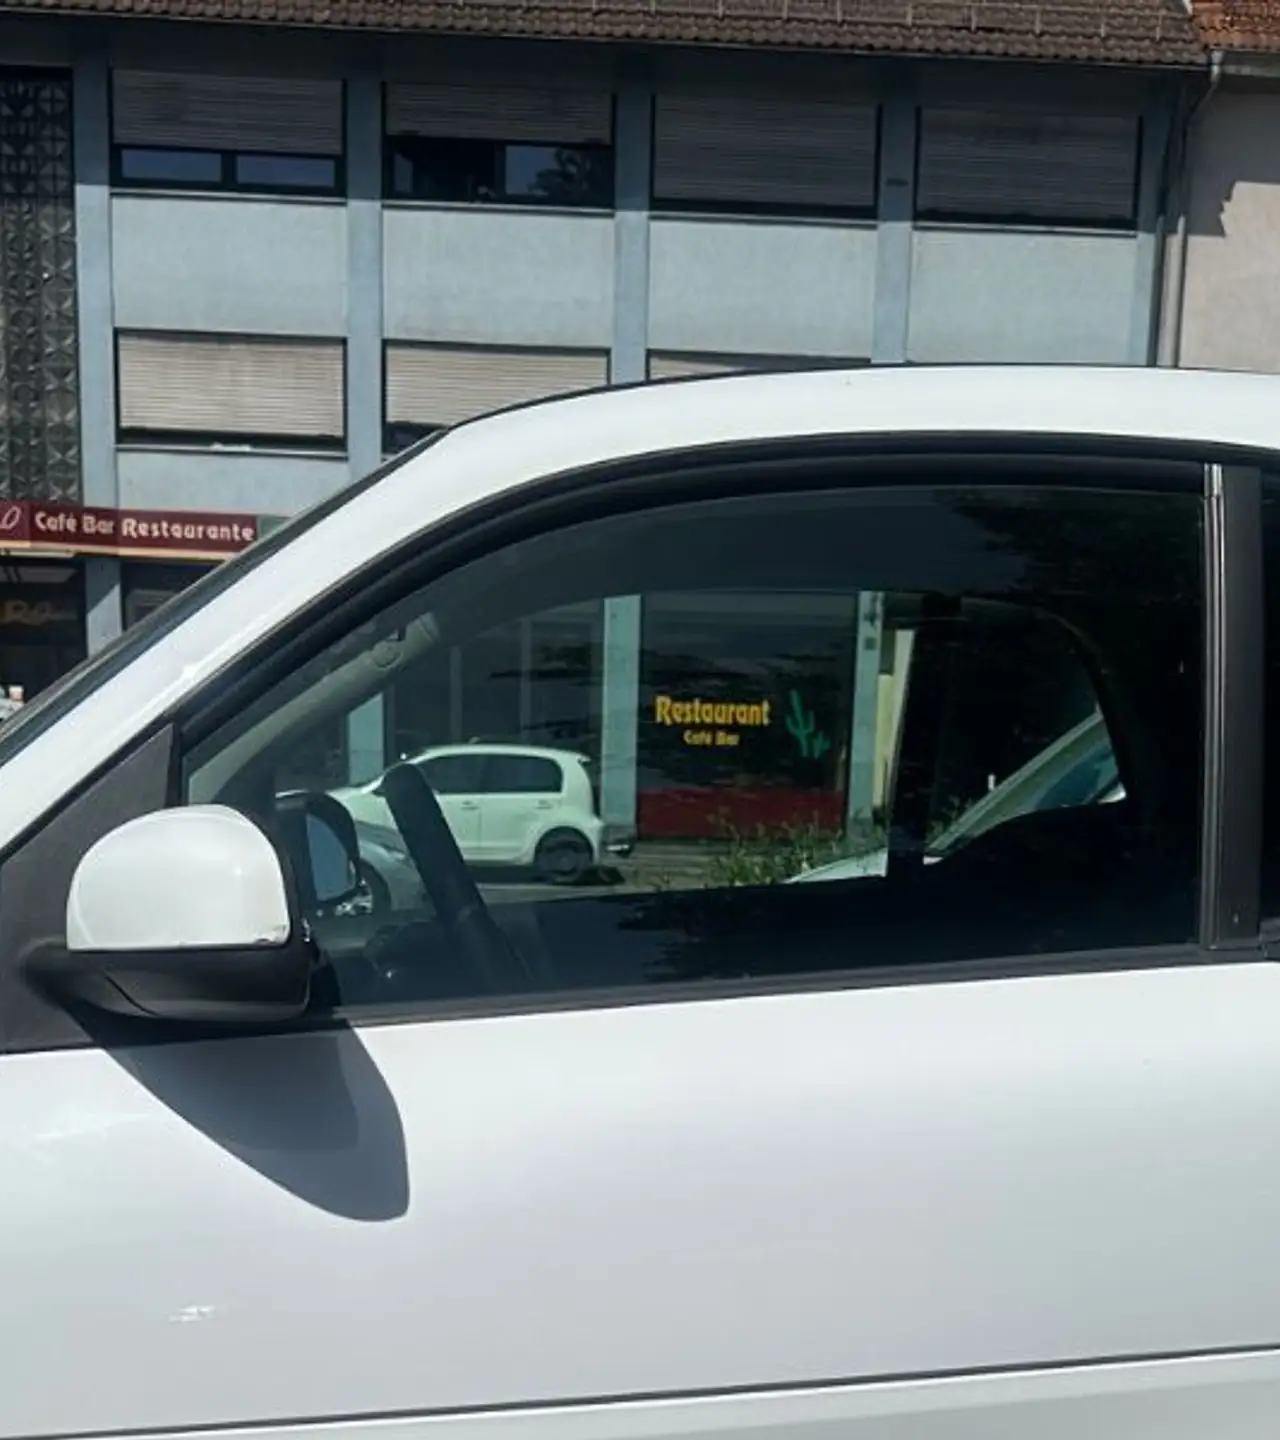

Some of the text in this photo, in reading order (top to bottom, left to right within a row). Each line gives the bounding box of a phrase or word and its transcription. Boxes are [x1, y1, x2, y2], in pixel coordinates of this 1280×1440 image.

[35, 511, 78, 532] Café
[82, 513, 114, 534] Bar
[122, 517, 255, 541] Restaurante
[655, 695, 770, 726] Restaurant
[683, 729, 740, 746] Café Bar
